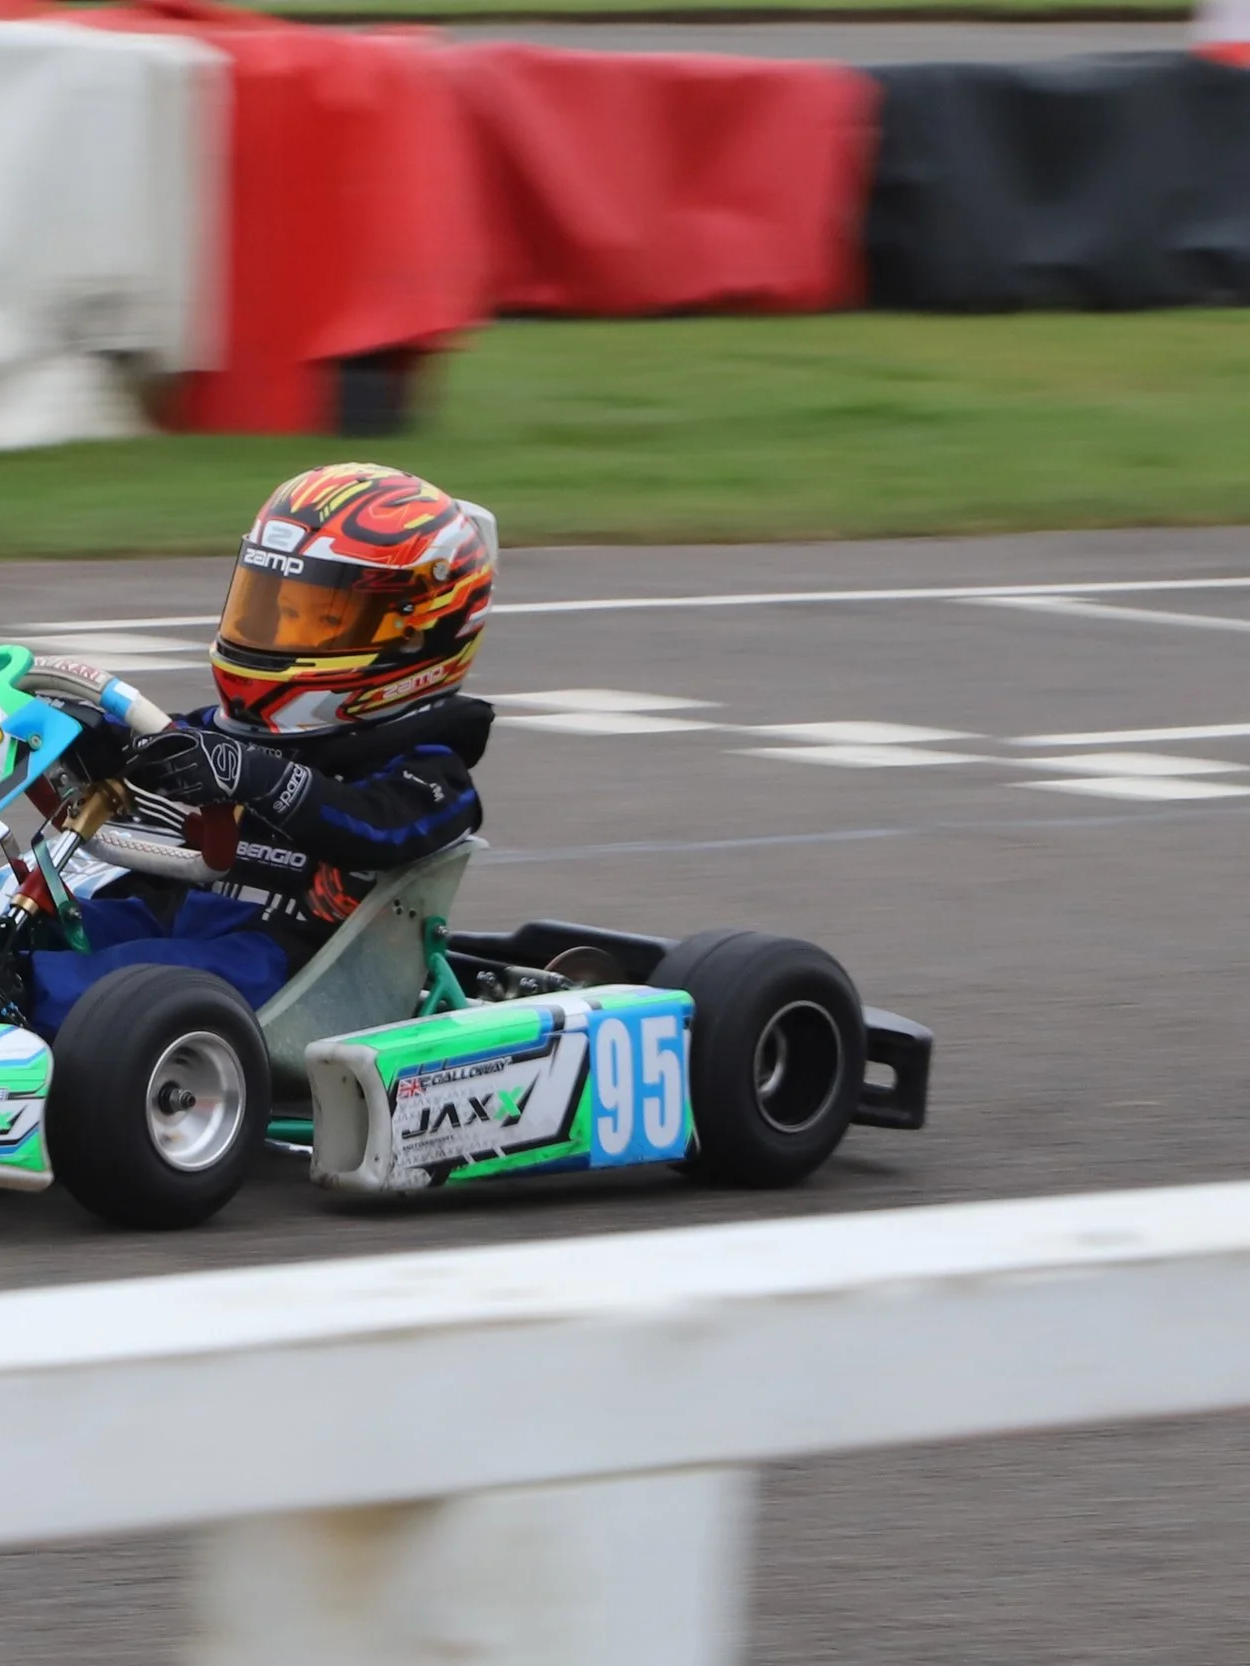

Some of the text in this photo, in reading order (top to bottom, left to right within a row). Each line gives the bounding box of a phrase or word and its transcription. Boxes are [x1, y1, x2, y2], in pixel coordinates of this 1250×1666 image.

[243, 547, 305, 577] zamp
[382, 665, 445, 699] zamp
[235, 840, 307, 868] BENGIO
[432, 1058, 508, 1086] GALLOWAY
[595, 1015, 684, 1155] 95
[401, 1083, 528, 1139] JAXX
